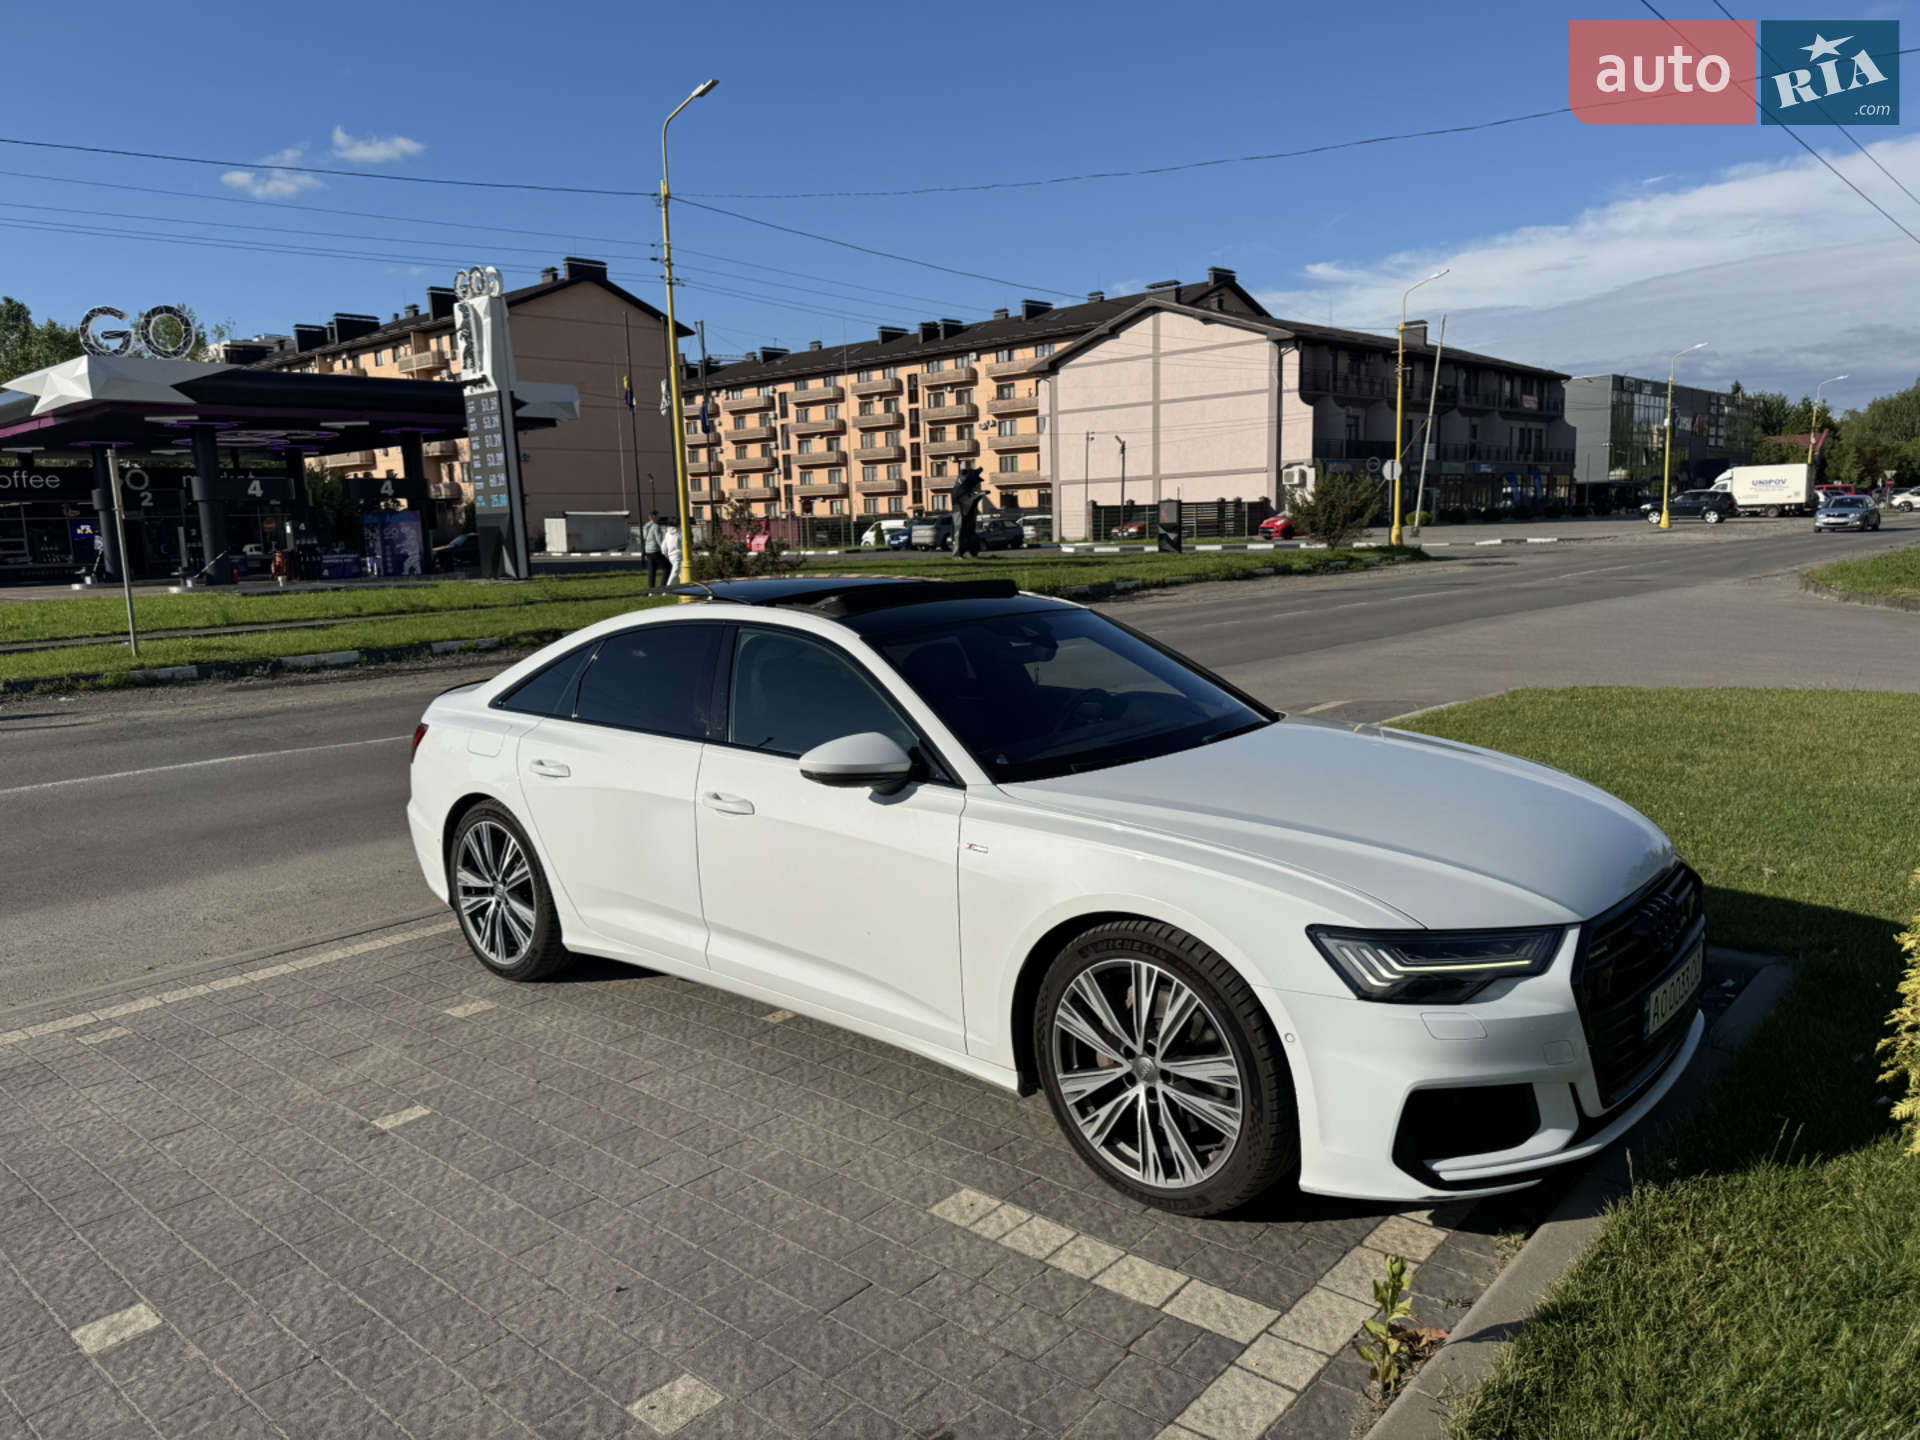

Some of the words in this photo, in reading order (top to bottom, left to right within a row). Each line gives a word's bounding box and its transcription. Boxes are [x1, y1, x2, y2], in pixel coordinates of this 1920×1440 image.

[79, 304, 196, 360] GO
[247, 480, 264, 497] 4
[380, 480, 395, 496] 4
[139, 491, 154, 507] 2
[1095, 938, 1169, 960] MICHELIN
